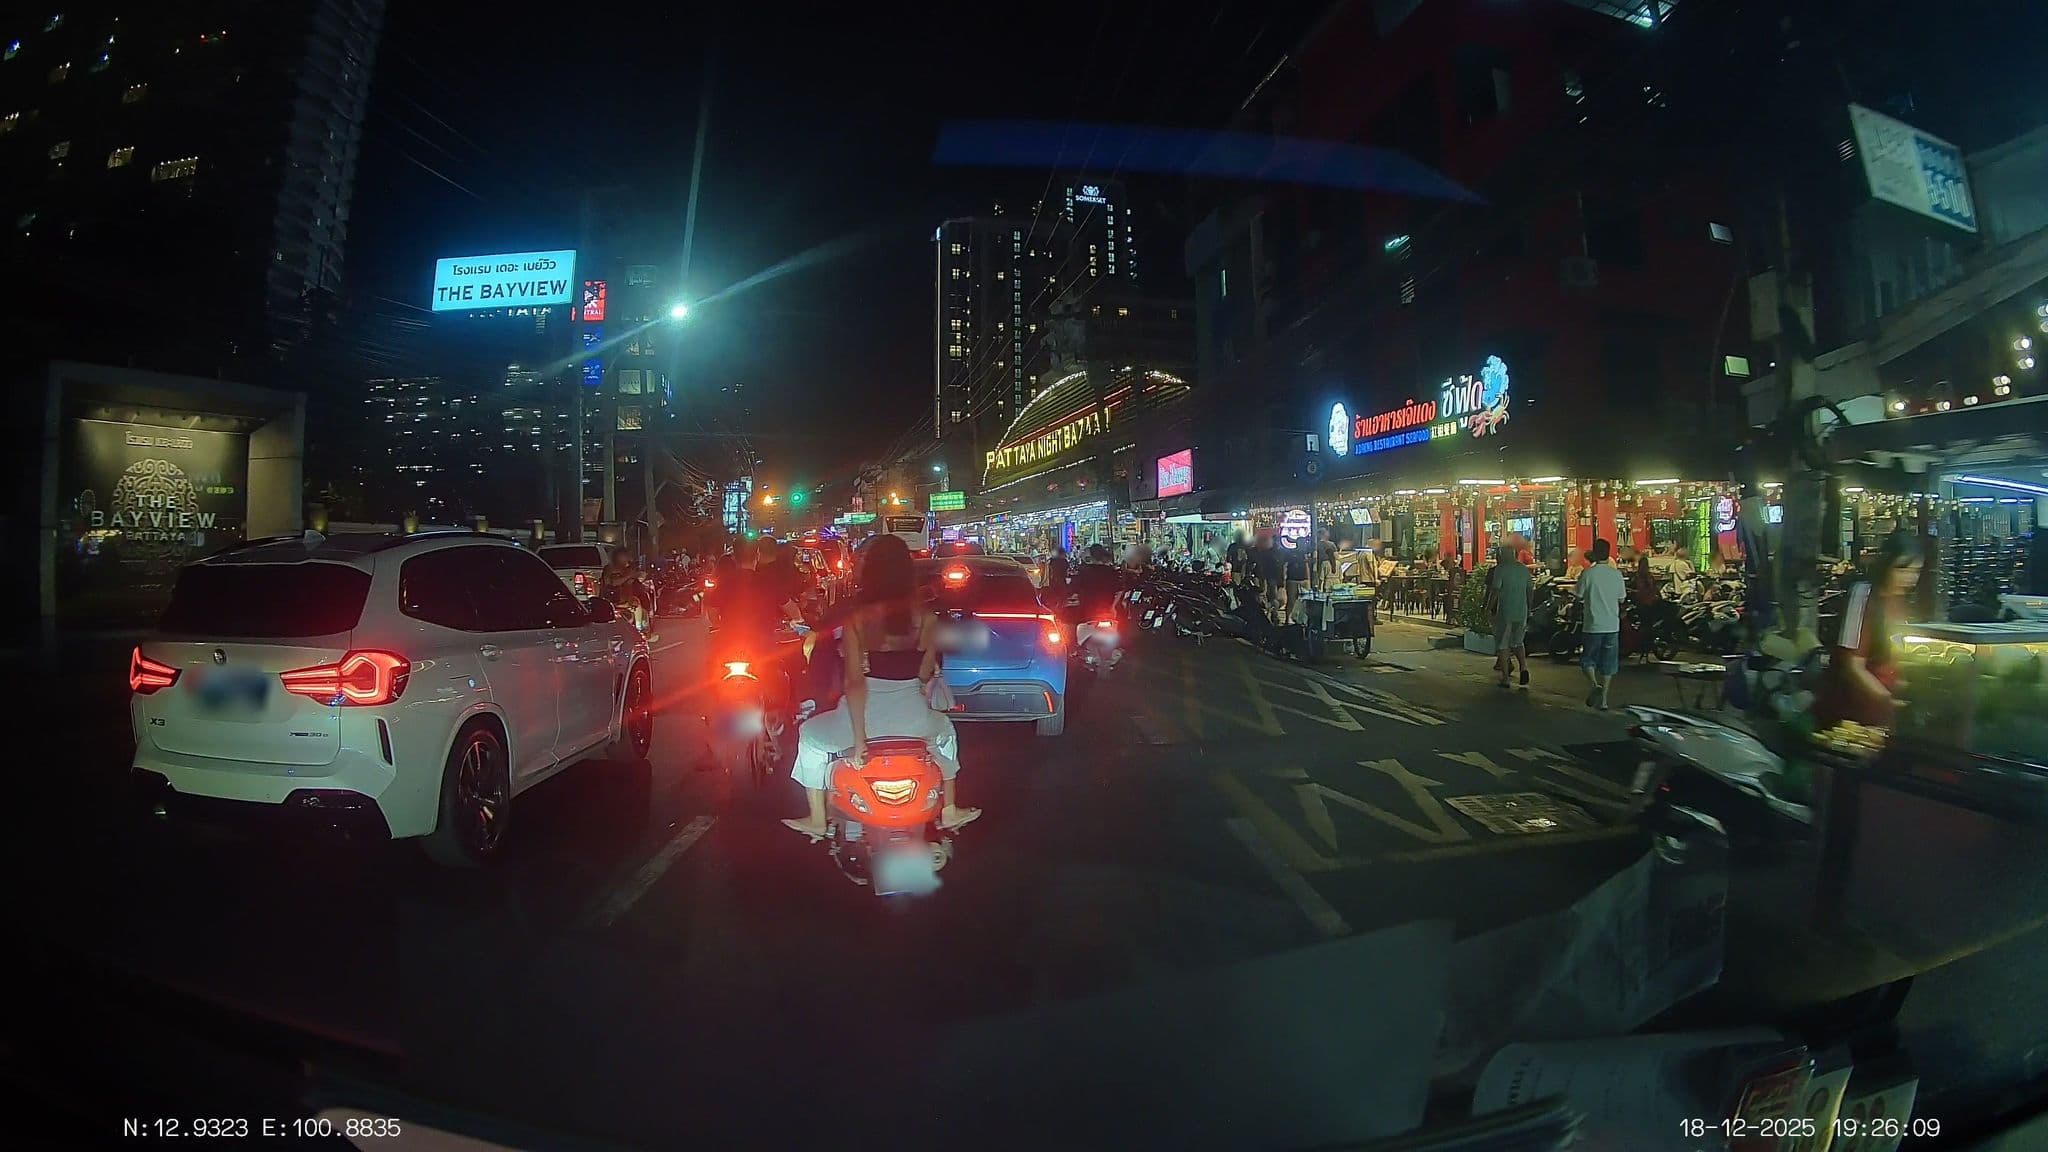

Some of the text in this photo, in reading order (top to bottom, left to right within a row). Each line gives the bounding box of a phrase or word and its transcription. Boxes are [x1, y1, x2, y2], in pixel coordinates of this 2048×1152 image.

[453, 264, 491, 276] โรงแรม
[495, 262, 519, 273] เดอะ
[437, 279, 568, 301] THE BAYVIEW
[985, 439, 1036, 470] PATTAYA
[1037, 428, 1062, 460] NIGHT
[135, 494, 177, 509] THE
[91, 510, 216, 528] BAYVIEW
[126, 531, 186, 541] PATTAYA
[150, 717, 165, 726] X3
